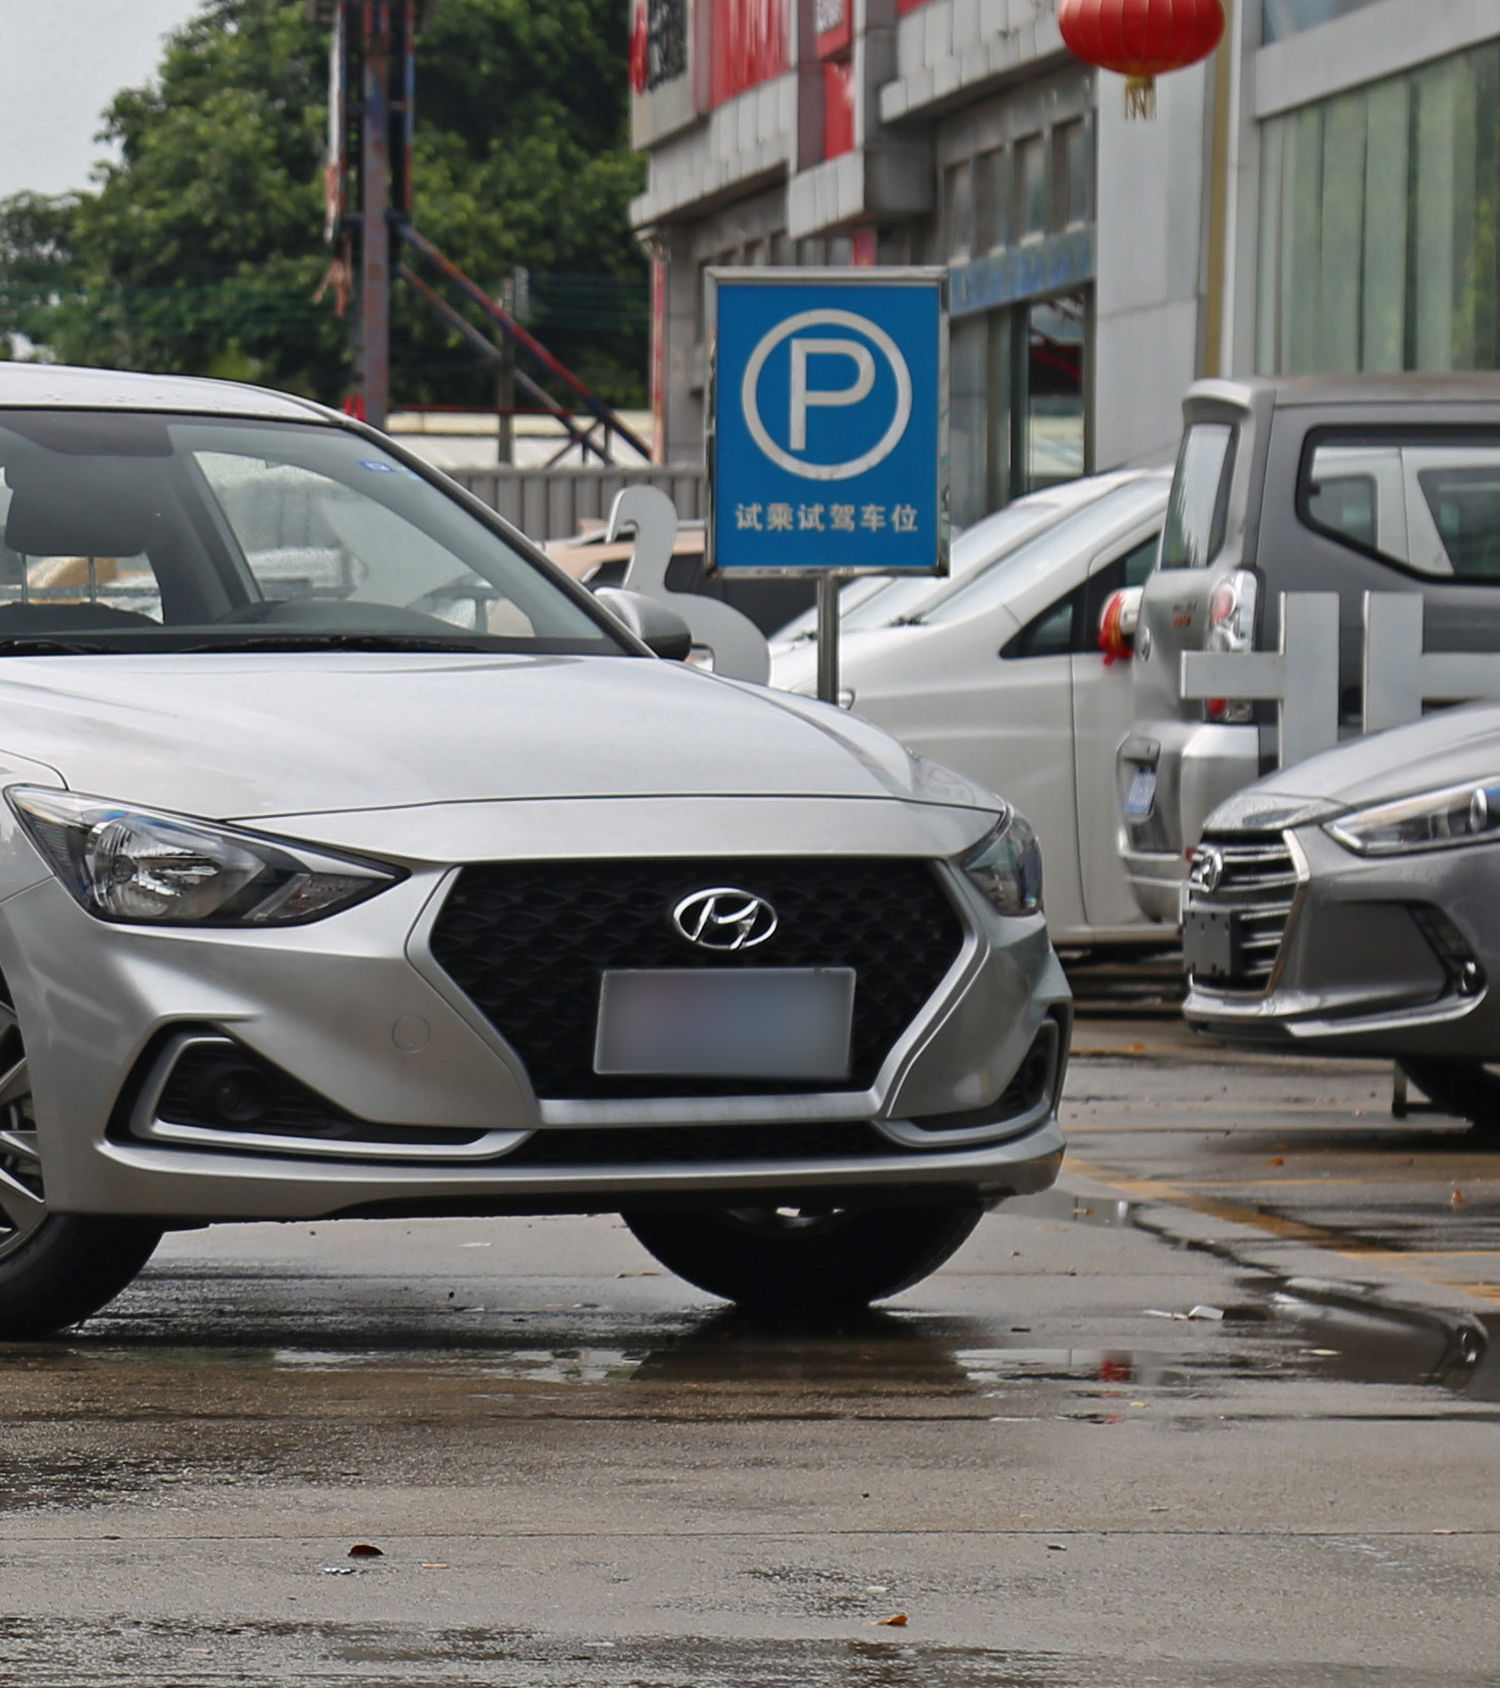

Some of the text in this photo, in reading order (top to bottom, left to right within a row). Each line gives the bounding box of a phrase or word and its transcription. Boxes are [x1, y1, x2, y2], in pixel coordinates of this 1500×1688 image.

[789, 338, 877, 450] P
[735, 502, 918, 532] 试乘试驾车位
